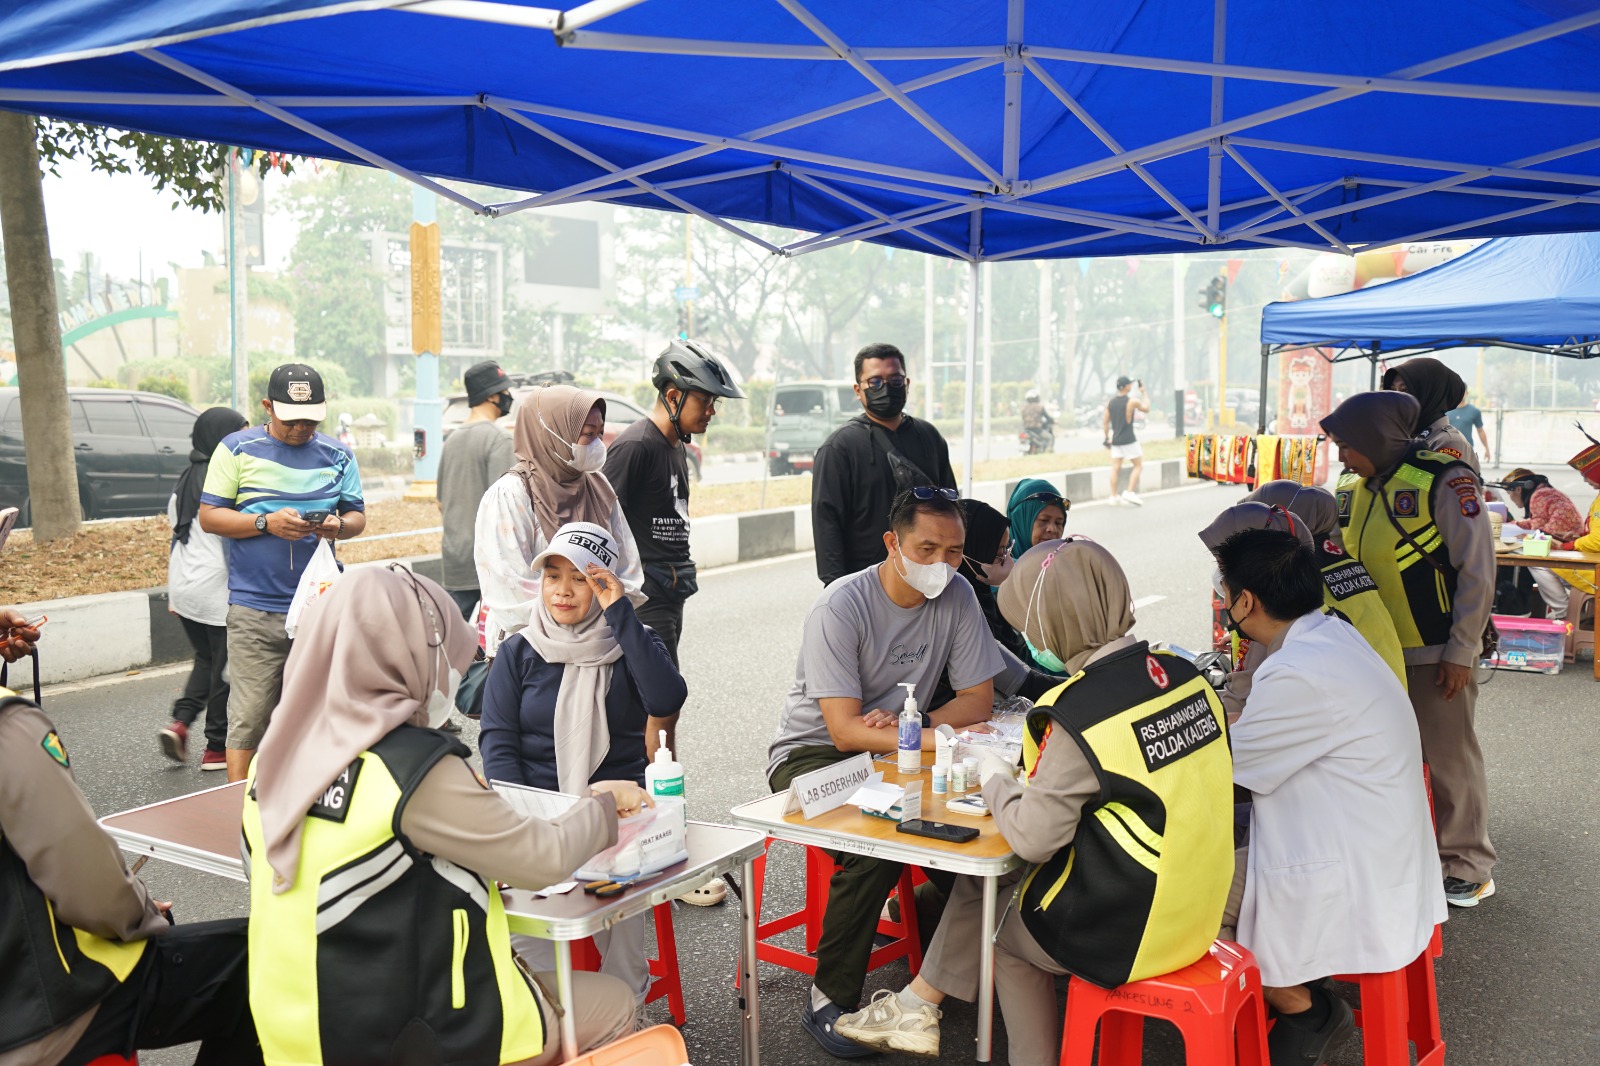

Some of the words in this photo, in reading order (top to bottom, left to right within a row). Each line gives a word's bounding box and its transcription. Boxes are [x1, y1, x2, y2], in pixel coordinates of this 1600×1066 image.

[1433, 244, 1453, 253] Fre
[569, 534, 612, 564] SPORT
[1330, 579, 1357, 597] POLDA
[1146, 733, 1187, 764] POLDA
[1183, 714, 1217, 747] KALTENG
[801, 786, 820, 806] LAB
[820, 767, 870, 800] SEDERHANA
[1184, 1001, 1195, 1014] 2
